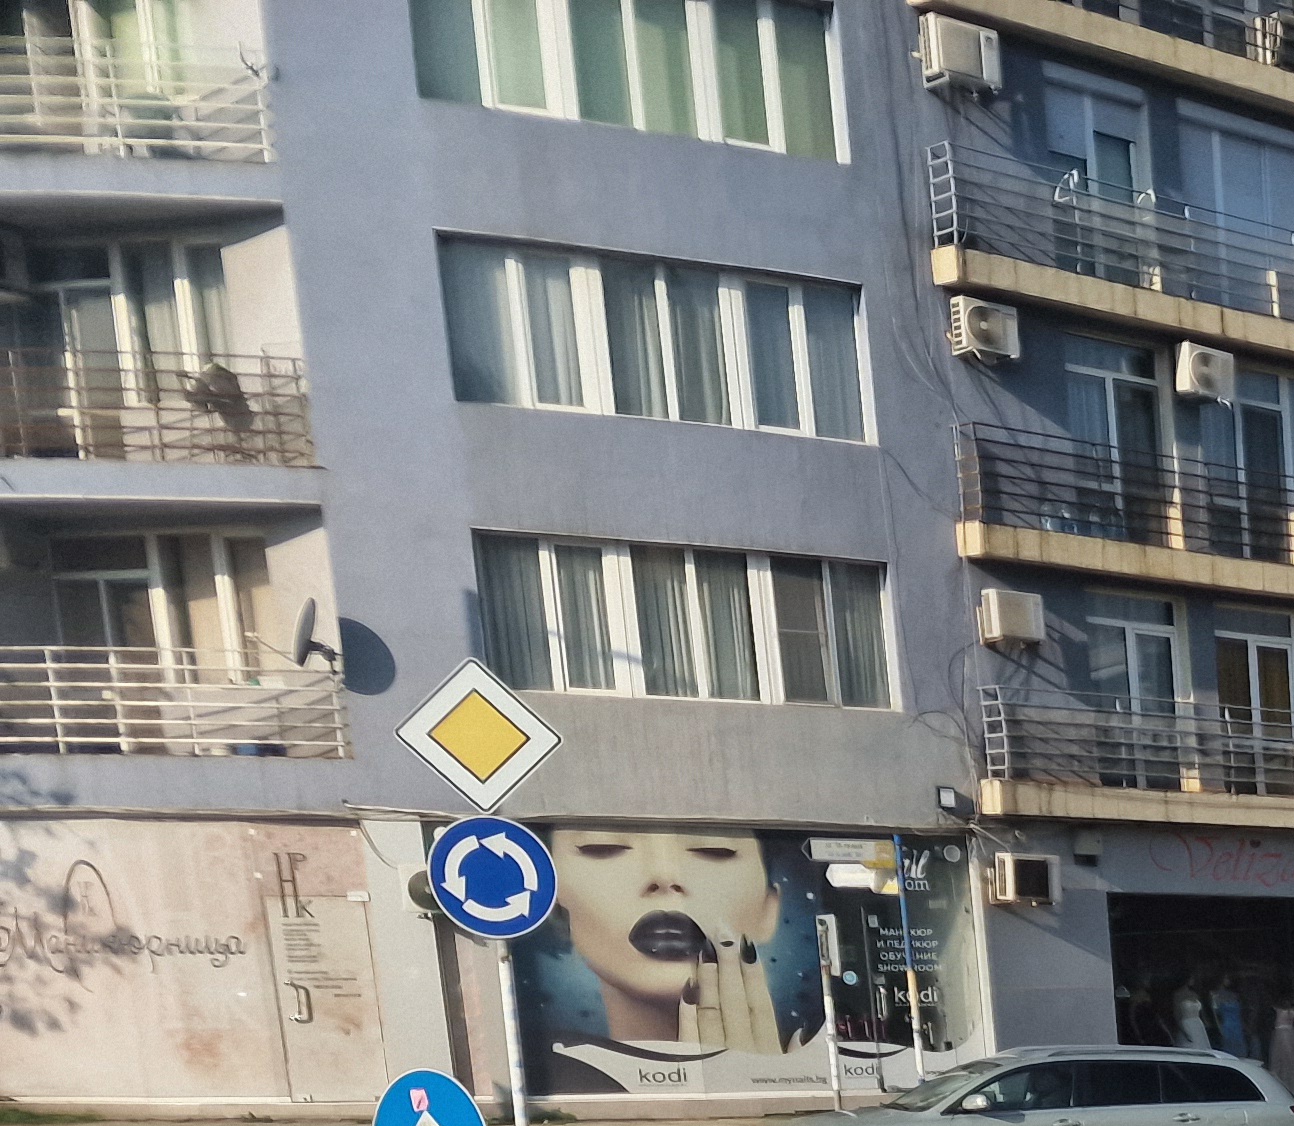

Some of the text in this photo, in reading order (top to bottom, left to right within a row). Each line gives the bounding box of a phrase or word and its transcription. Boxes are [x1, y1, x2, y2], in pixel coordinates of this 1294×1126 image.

[880, 928, 933, 936] МАНКЮР
[894, 986, 938, 1003] kdi
[639, 1067, 687, 1083] kodi
